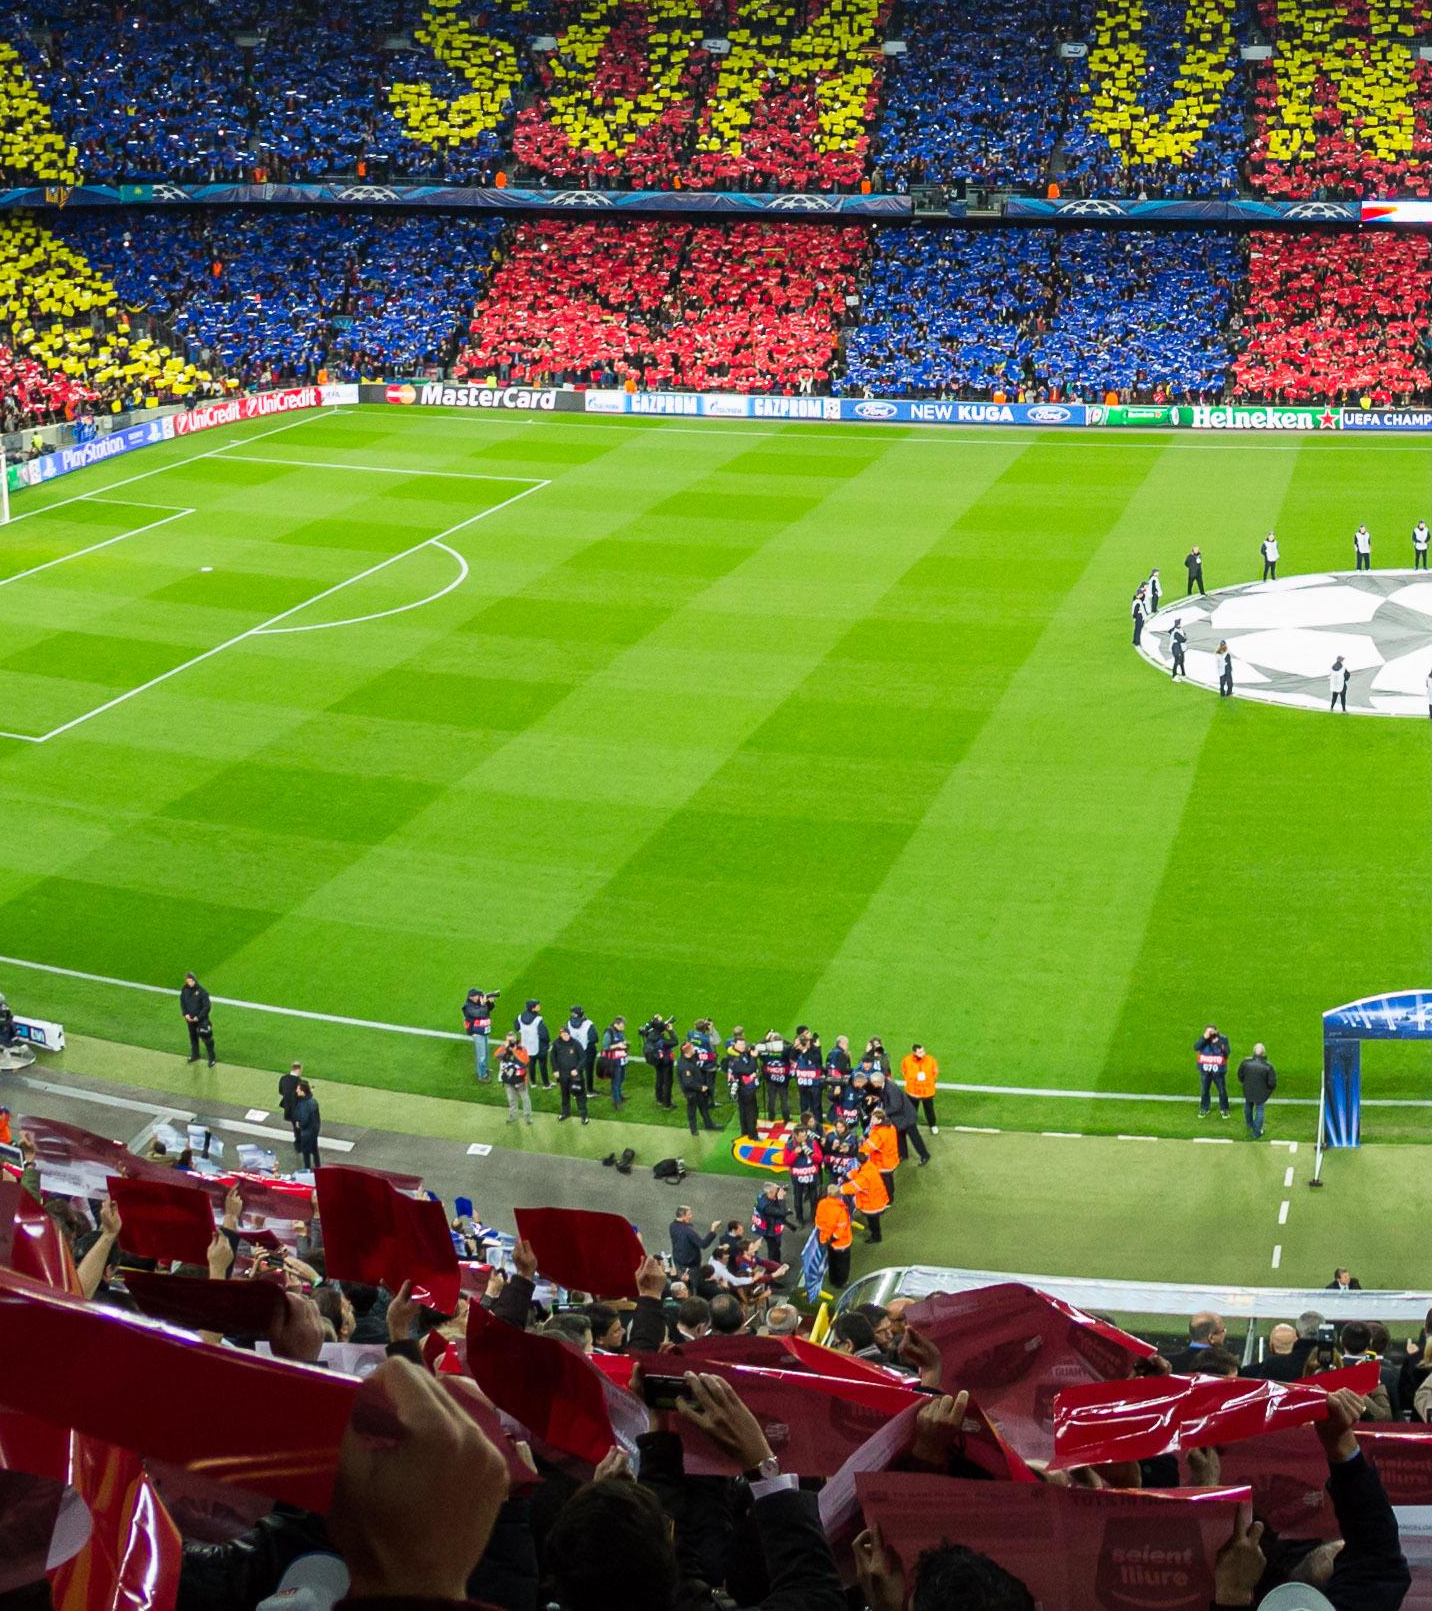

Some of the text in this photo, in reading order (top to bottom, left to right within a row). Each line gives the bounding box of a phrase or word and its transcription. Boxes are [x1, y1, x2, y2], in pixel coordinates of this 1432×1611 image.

[421, 385, 556, 410] MasterCard
[632, 393, 697, 414] GAZPROM
[755, 399, 822, 418] GAZPROM
[189, 389, 316, 432] UniCredit UniCredit
[861, 404, 1064, 421] Ford NEW KUGA Ford
[1192, 407, 1313, 429] Heineken
[1345, 413, 1380, 426] UEFA
[62, 436, 125, 471] PlayStation
[1111, 1542, 1193, 1566] seient
[1119, 1564, 1190, 1588] lliure
